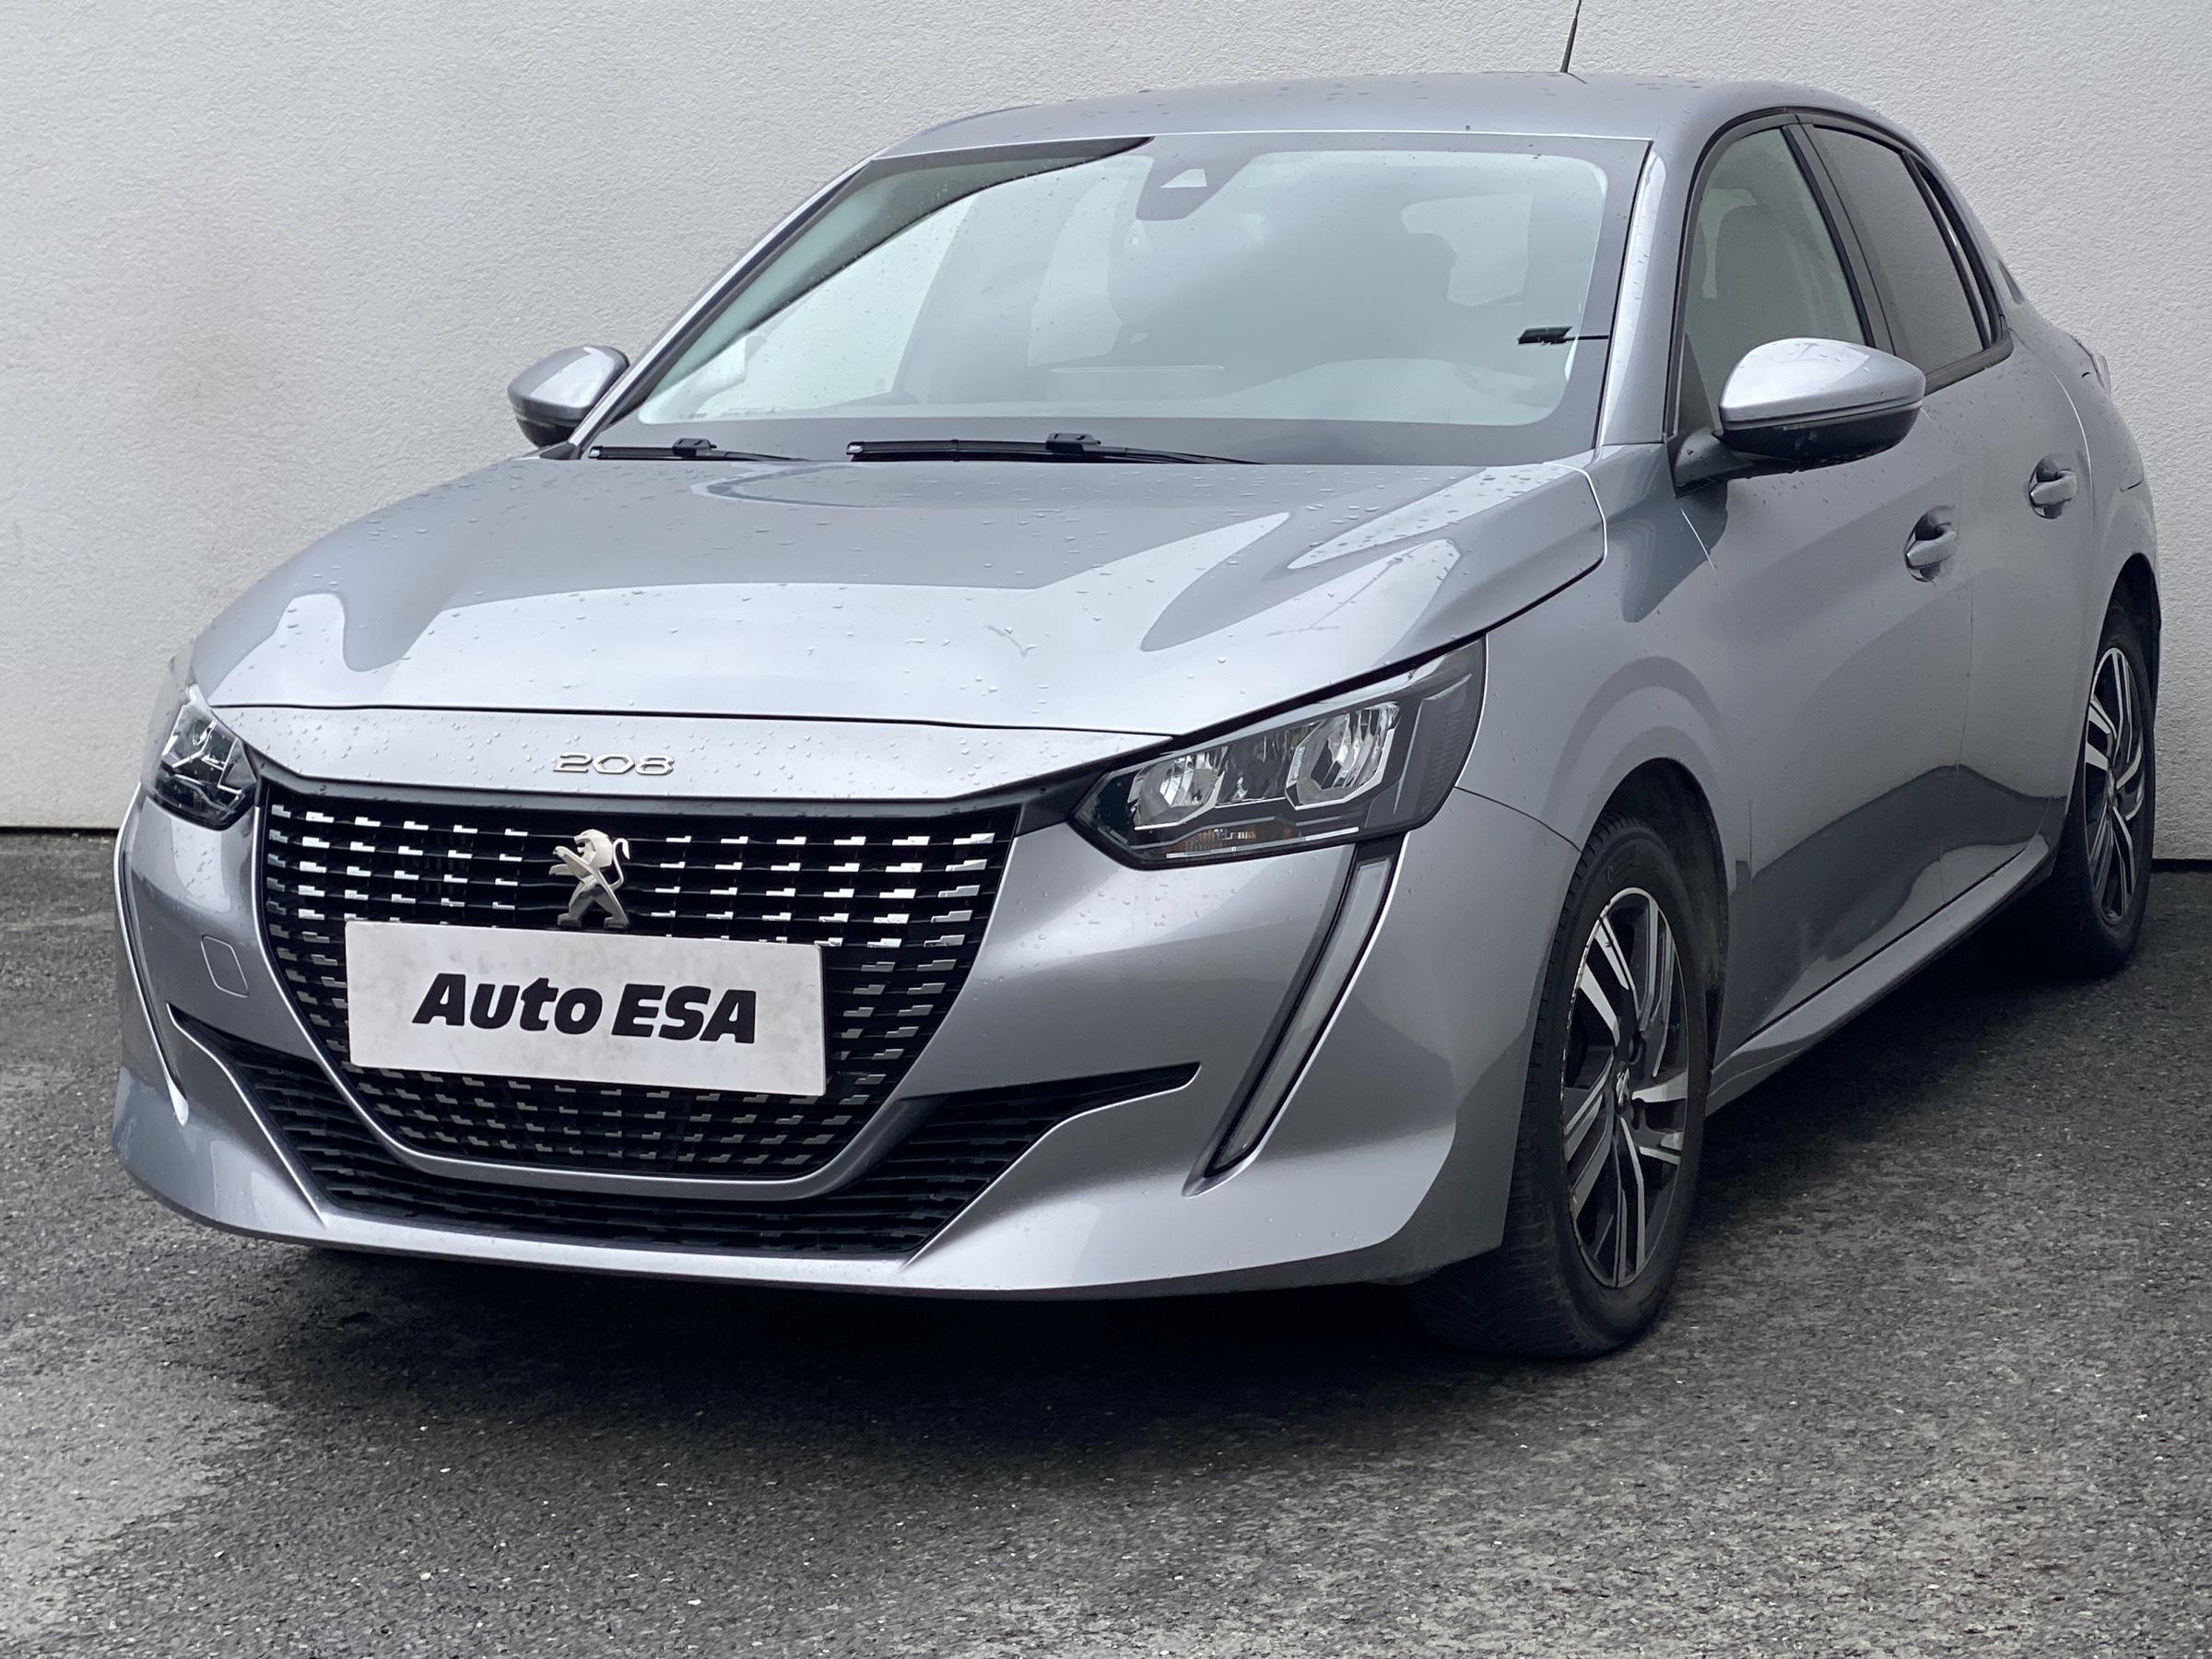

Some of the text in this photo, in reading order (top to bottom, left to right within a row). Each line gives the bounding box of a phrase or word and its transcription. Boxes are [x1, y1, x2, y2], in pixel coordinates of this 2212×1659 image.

[553, 752, 675, 776] 208
[412, 972, 757, 1044] Auto ESA
